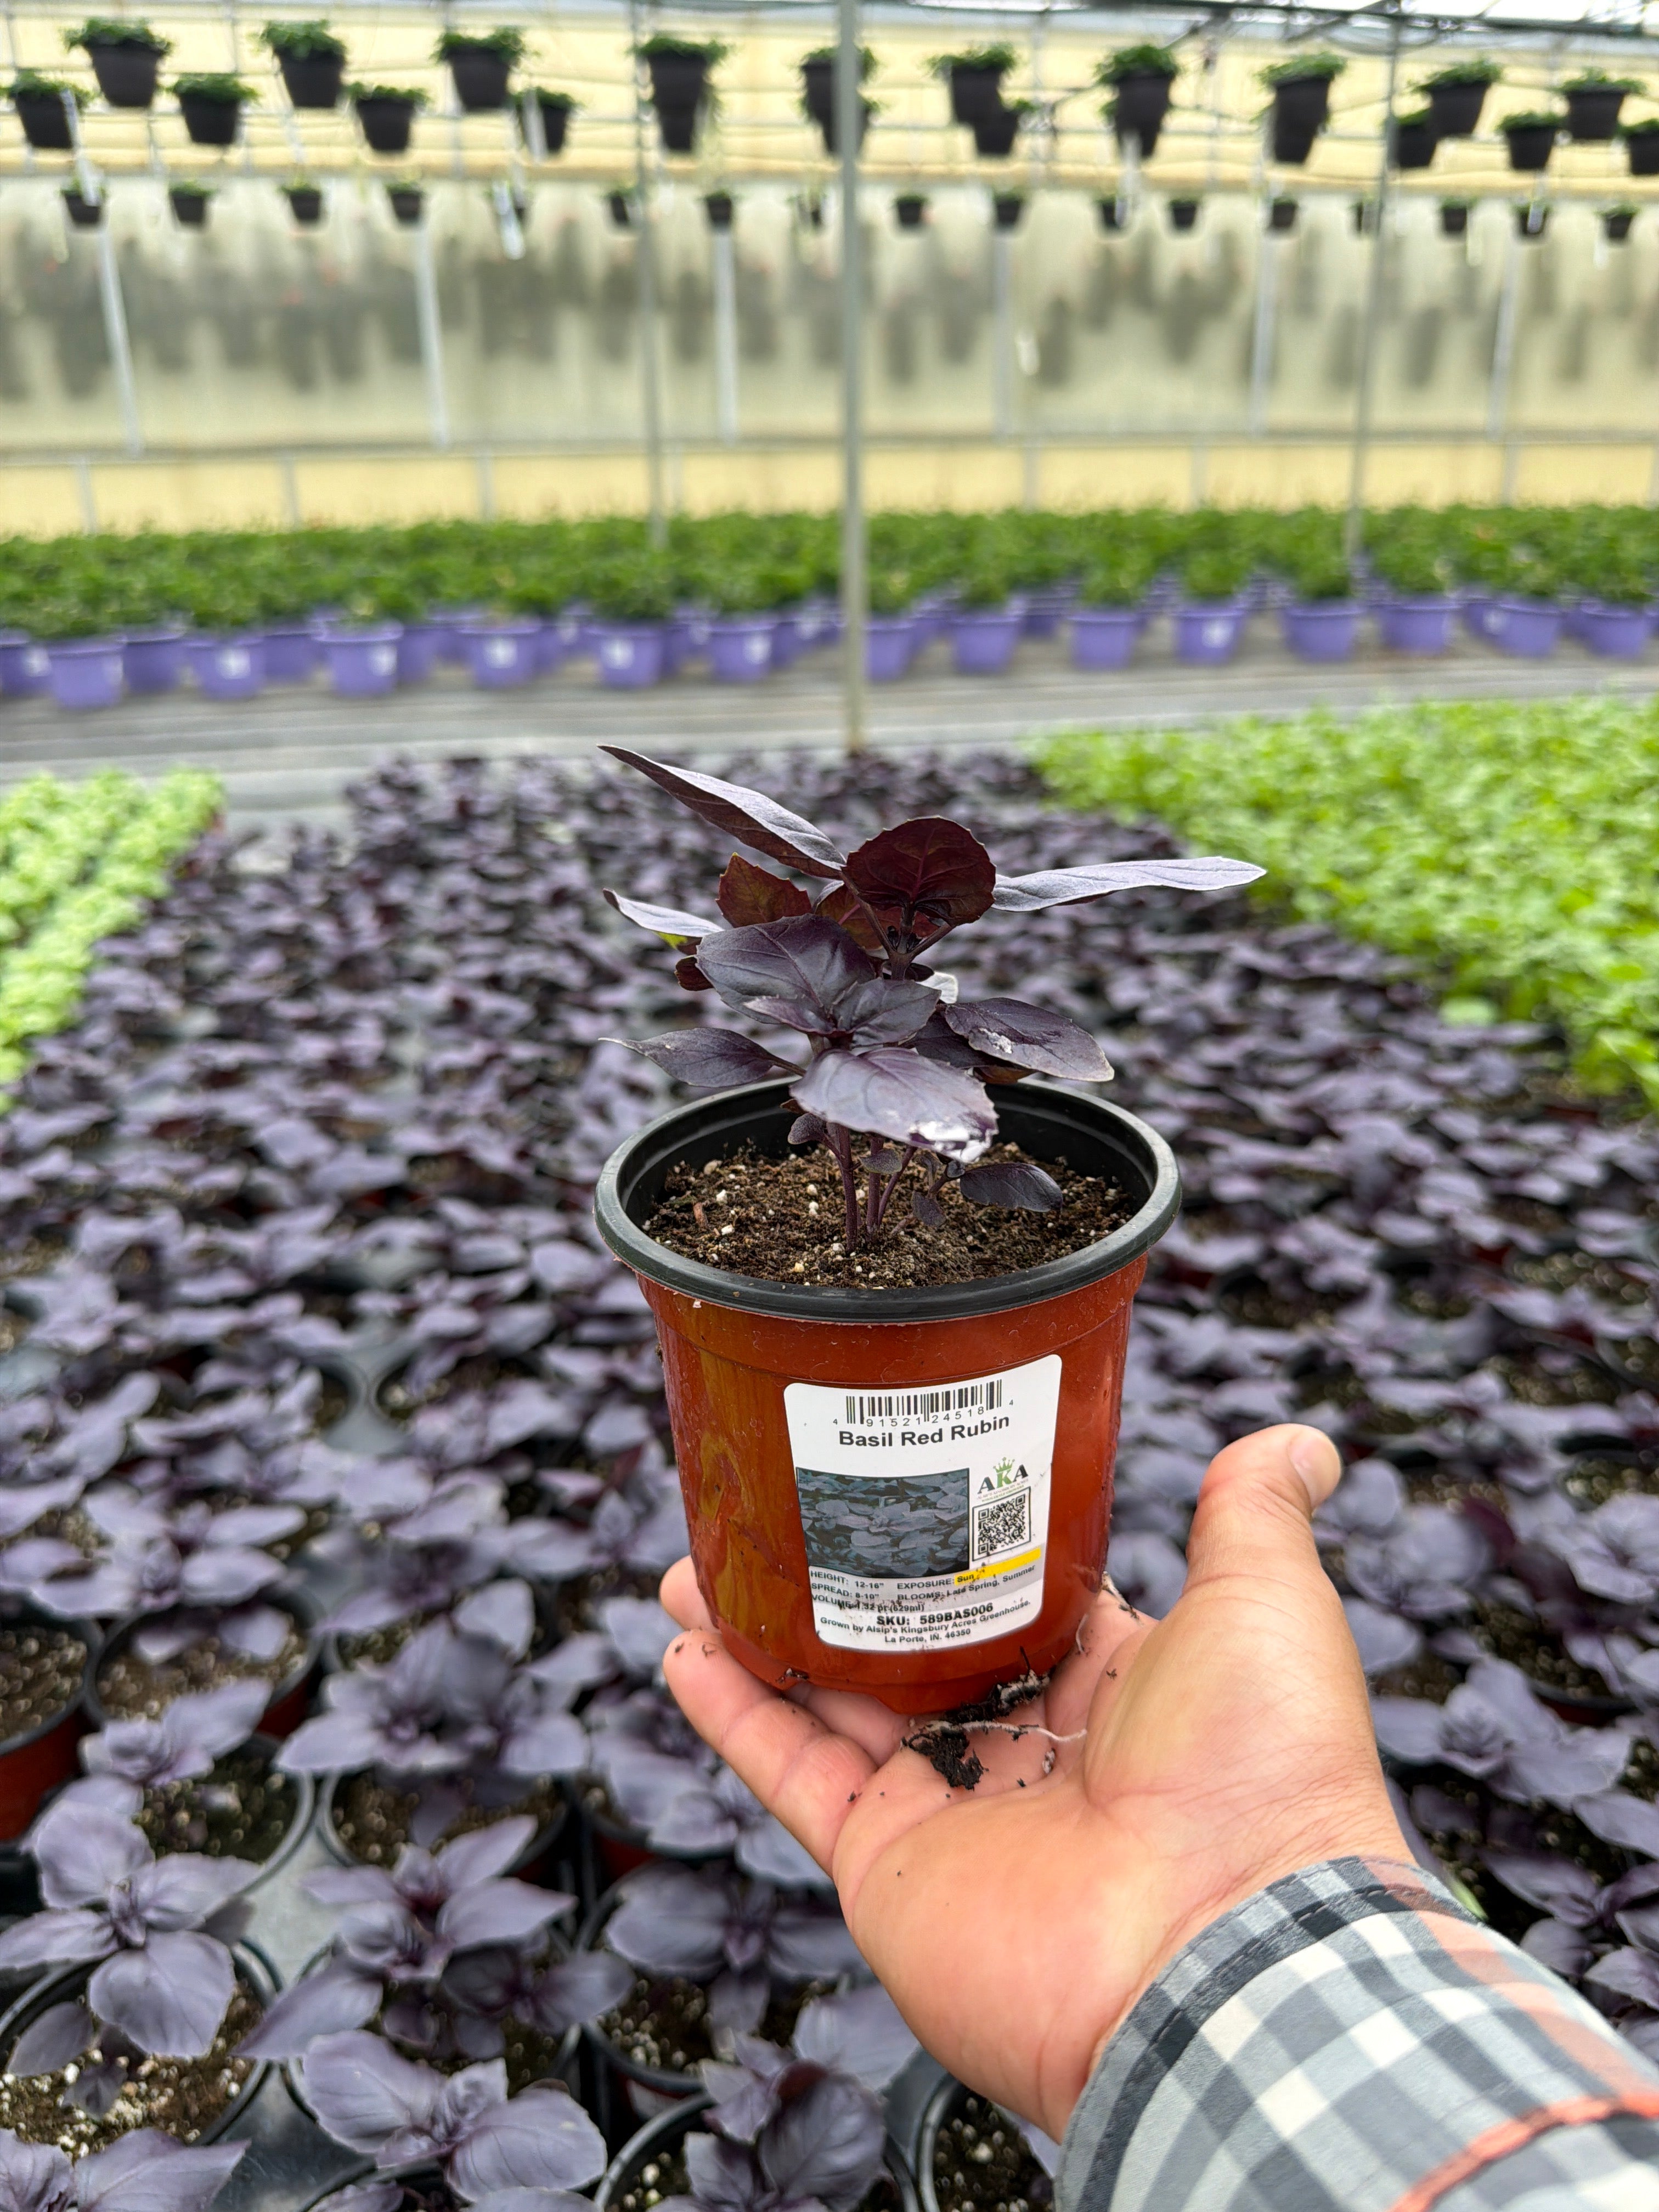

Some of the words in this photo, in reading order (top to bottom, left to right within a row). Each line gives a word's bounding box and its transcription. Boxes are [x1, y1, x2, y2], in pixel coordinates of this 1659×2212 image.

[866, 1417, 921, 1427] 91521
[932, 1406, 984, 1424] 24518
[839, 1430, 893, 1447] Basil
[901, 1428, 943, 1446] Red
[951, 1416, 1009, 1441] Rubin
[977, 1464, 1029, 1494] AKA
[810, 1570, 849, 1585] HEIGHT:
[855, 1581, 884, 1589] 12-16"
[897, 1578, 953, 1589] EXPOSURE:
[957, 1573, 974, 1583] Sun
[897, 1591, 944, 1601] BLOOMS:
[1002, 1565, 1036, 1583] Summer
[811, 1583, 852, 1597] SPREAD:
[877, 1615, 910, 1626] SKU:
[919, 1602, 994, 1624] 589BAS006
[820, 1617, 850, 1630] Grown
[853, 1623, 864, 1633] by
[866, 1625, 898, 1634] Alsip's
[901, 1623, 950, 1634] Kingsbury
[951, 1617, 977, 1629] Acres
[945, 1628, 971, 1639] 46350
